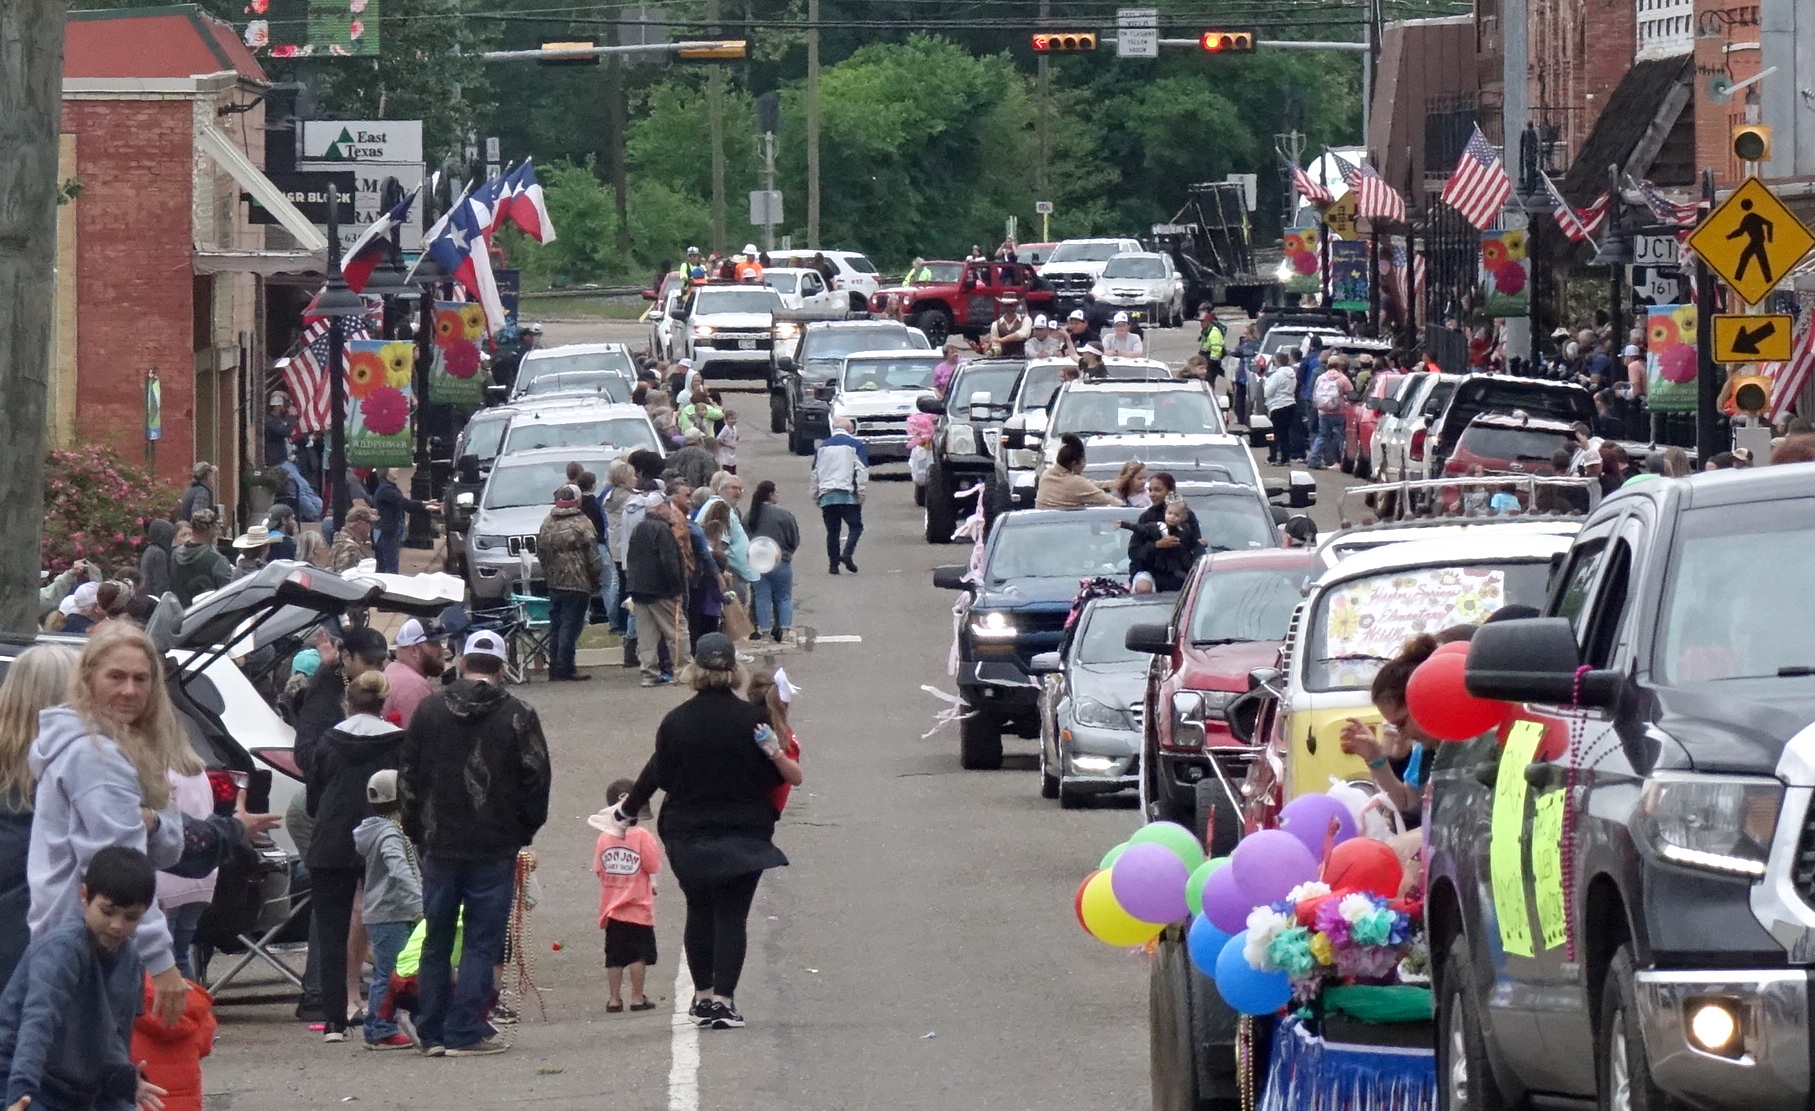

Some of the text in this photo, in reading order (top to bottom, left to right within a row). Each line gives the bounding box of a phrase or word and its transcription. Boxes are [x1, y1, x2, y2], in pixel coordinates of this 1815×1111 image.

[357, 131, 387, 143] East
[345, 144, 383, 157] Texas
[1637, 236, 1675, 259] JCT
[1651, 281, 1672, 295] 161
[620, 852, 640, 865] JON
